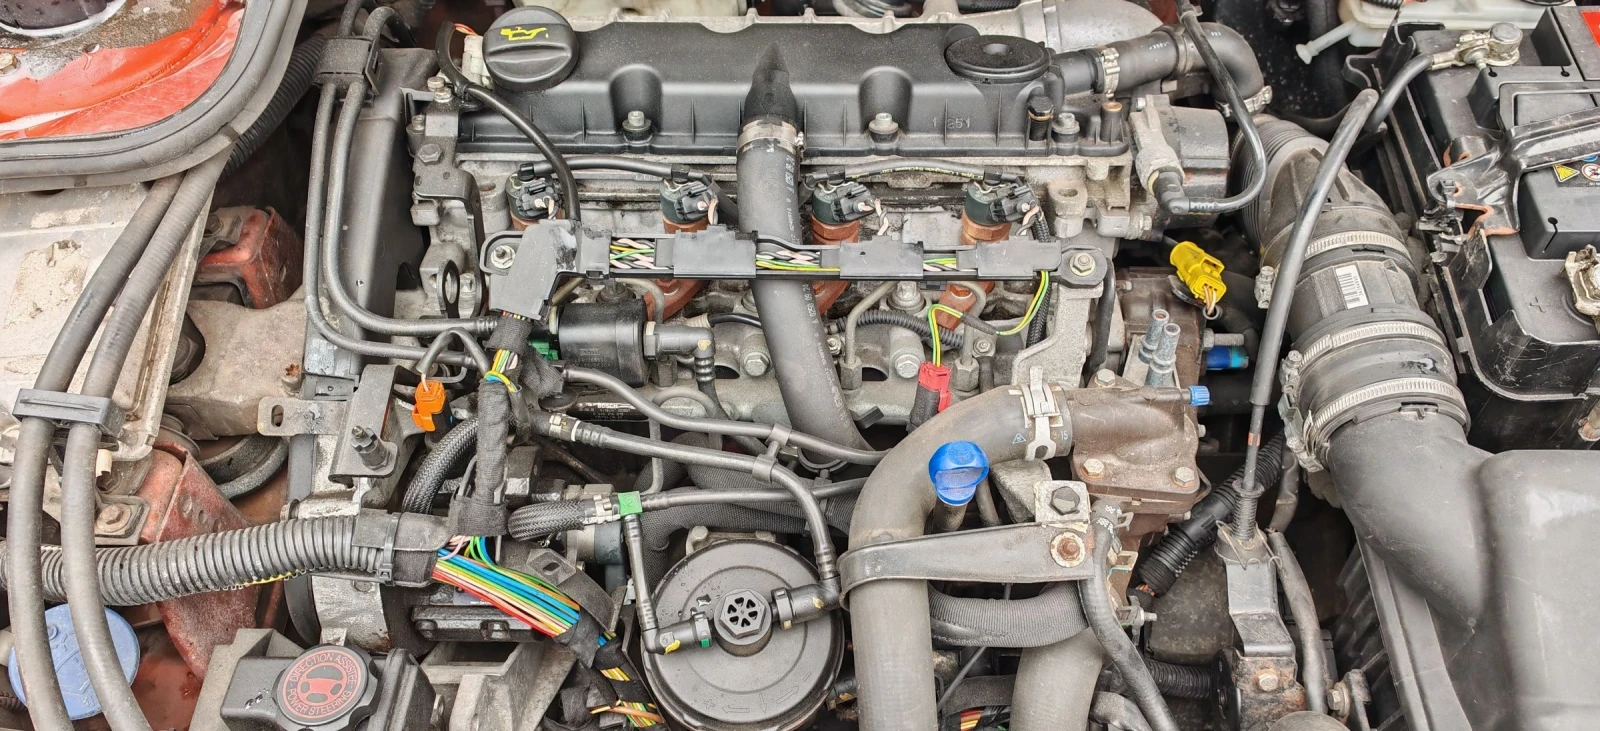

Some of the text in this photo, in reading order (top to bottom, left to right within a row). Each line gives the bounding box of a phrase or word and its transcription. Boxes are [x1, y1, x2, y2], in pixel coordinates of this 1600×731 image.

[290, 653, 333, 682] DIRECTION
[288, 688, 352, 715] POWER STEERING
